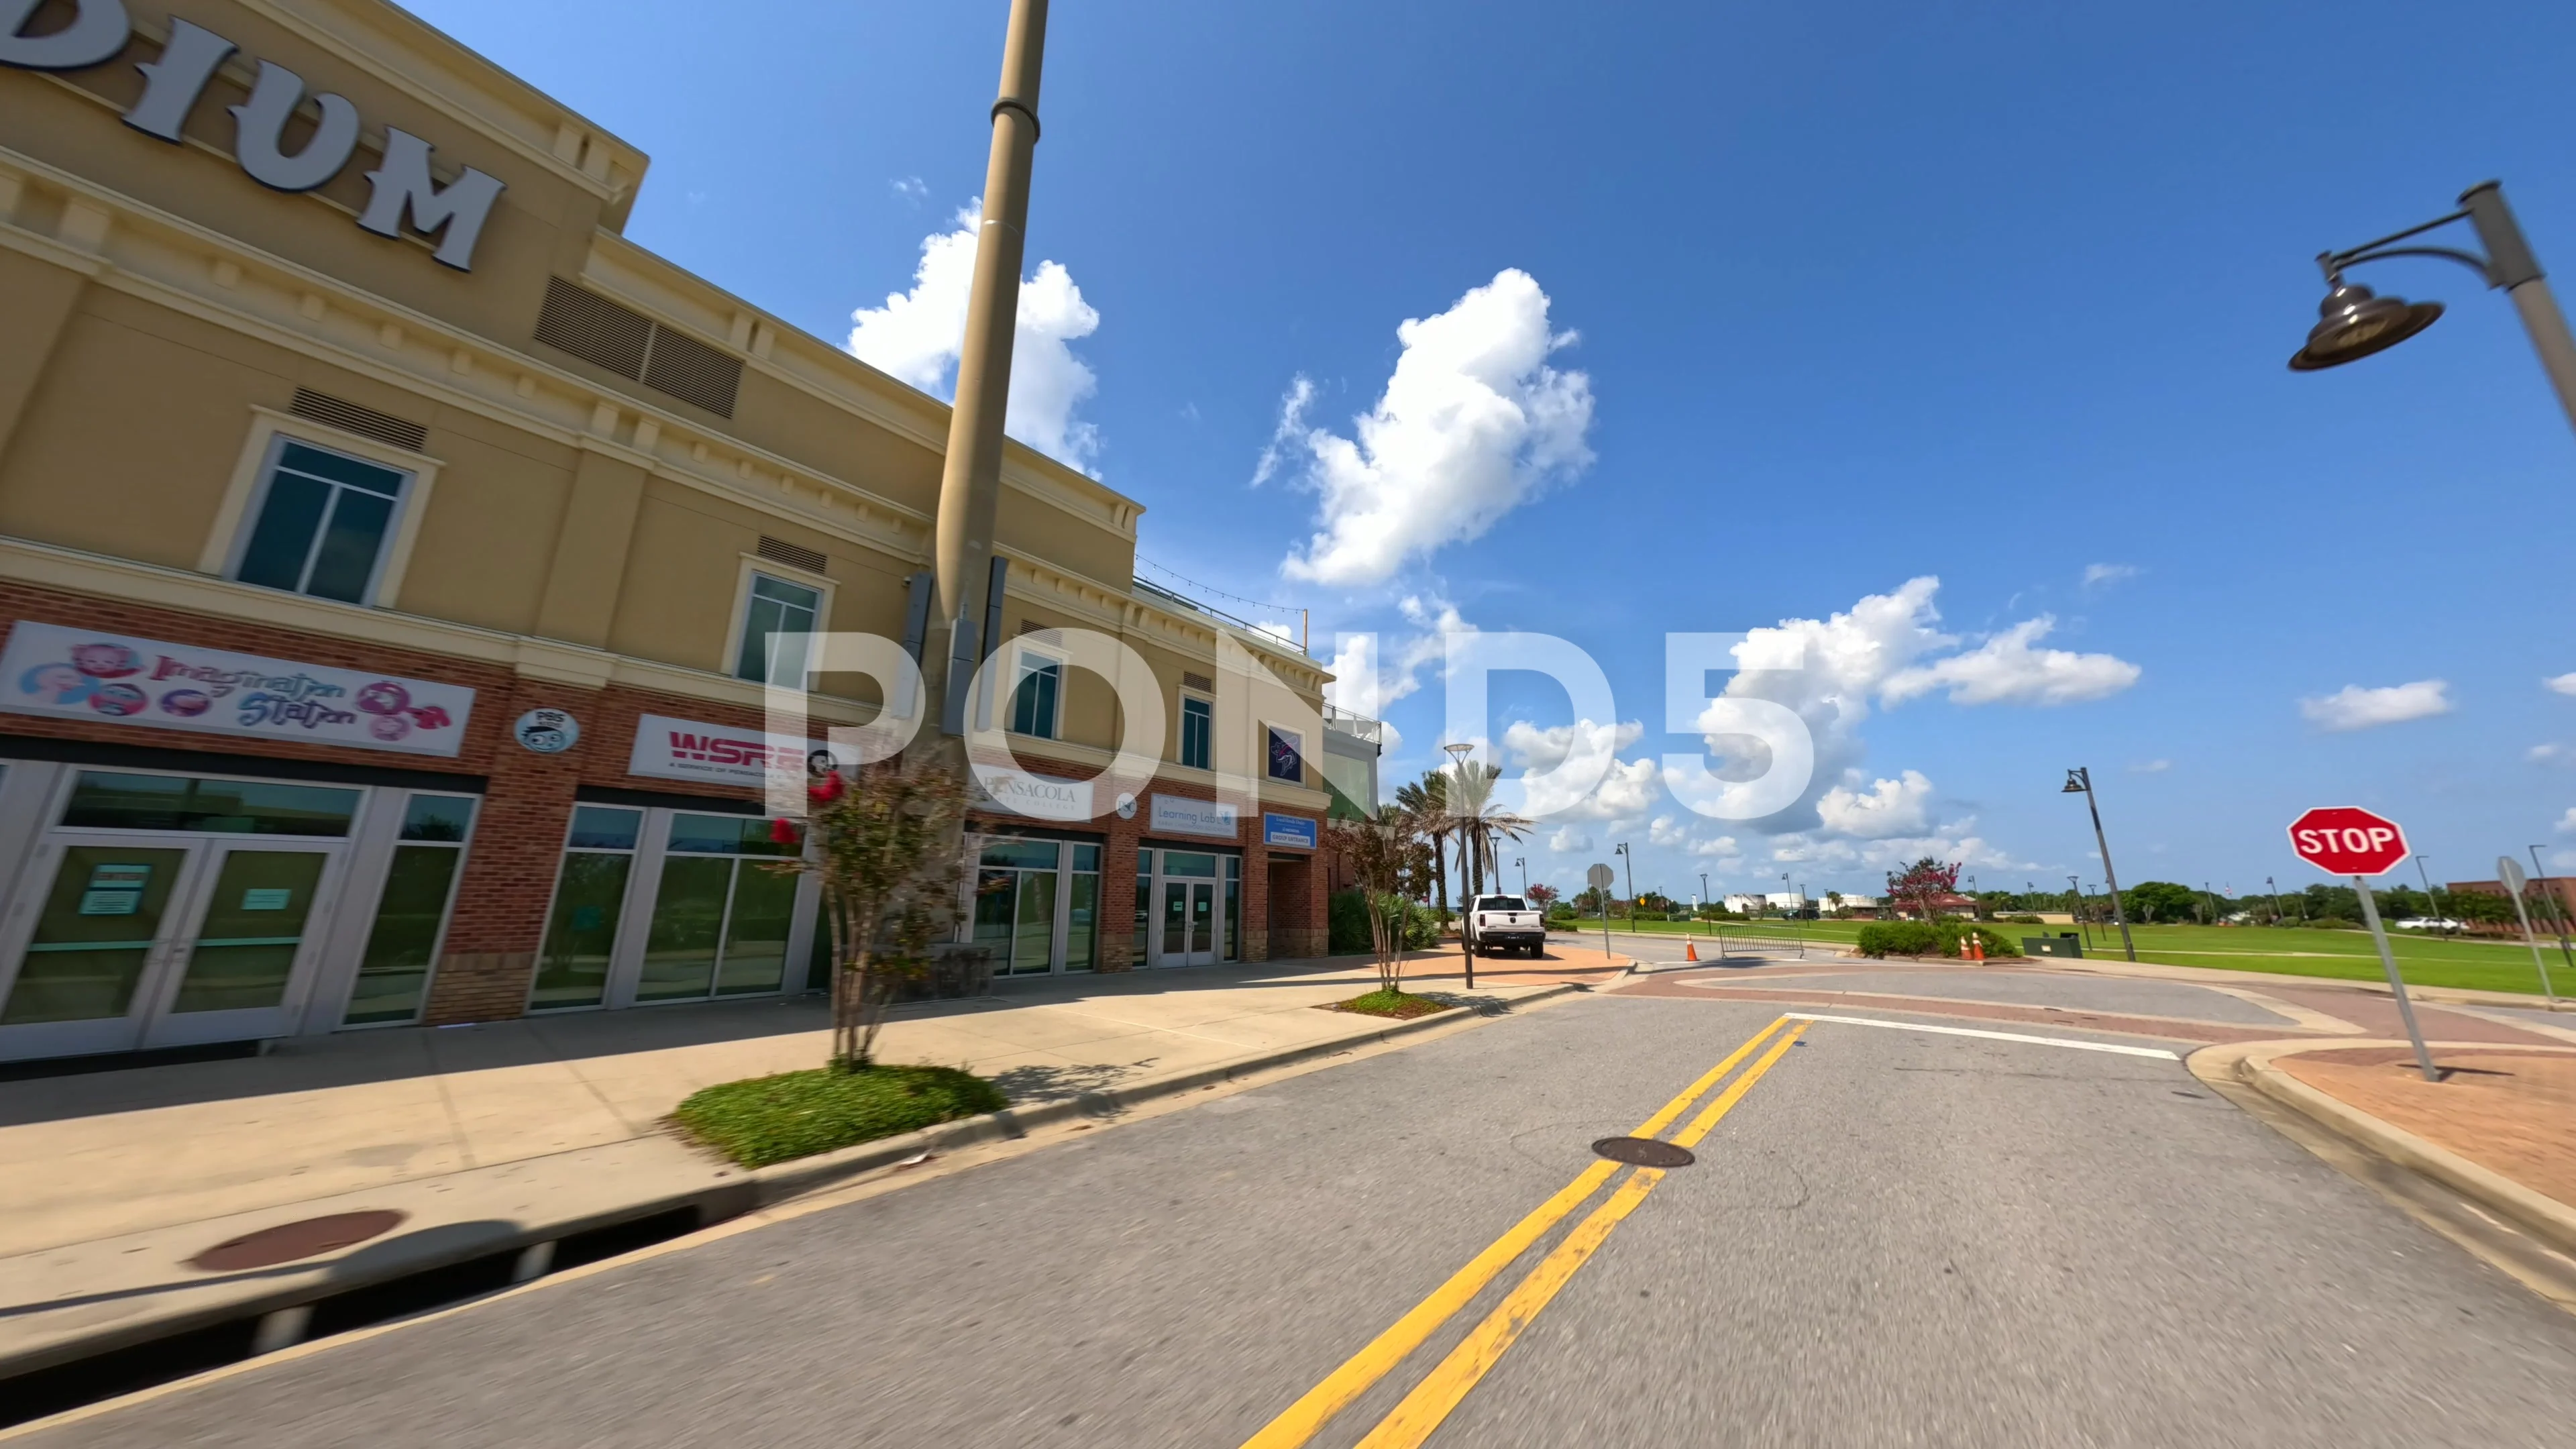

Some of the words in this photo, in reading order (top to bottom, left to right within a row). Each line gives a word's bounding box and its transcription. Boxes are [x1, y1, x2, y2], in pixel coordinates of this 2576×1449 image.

[146, 655, 347, 700] Imagination
[237, 692, 358, 729] Station
[535, 711, 565, 722] PBS
[668, 731, 804, 771] WSRE
[678, 763, 713, 772] SERVICE
[984, 776, 1076, 803] PNSACOLA
[1159, 806, 1197, 825] Learning
[1200, 811, 1216, 824] Lab
[2298, 826, 2395, 854] STOP
